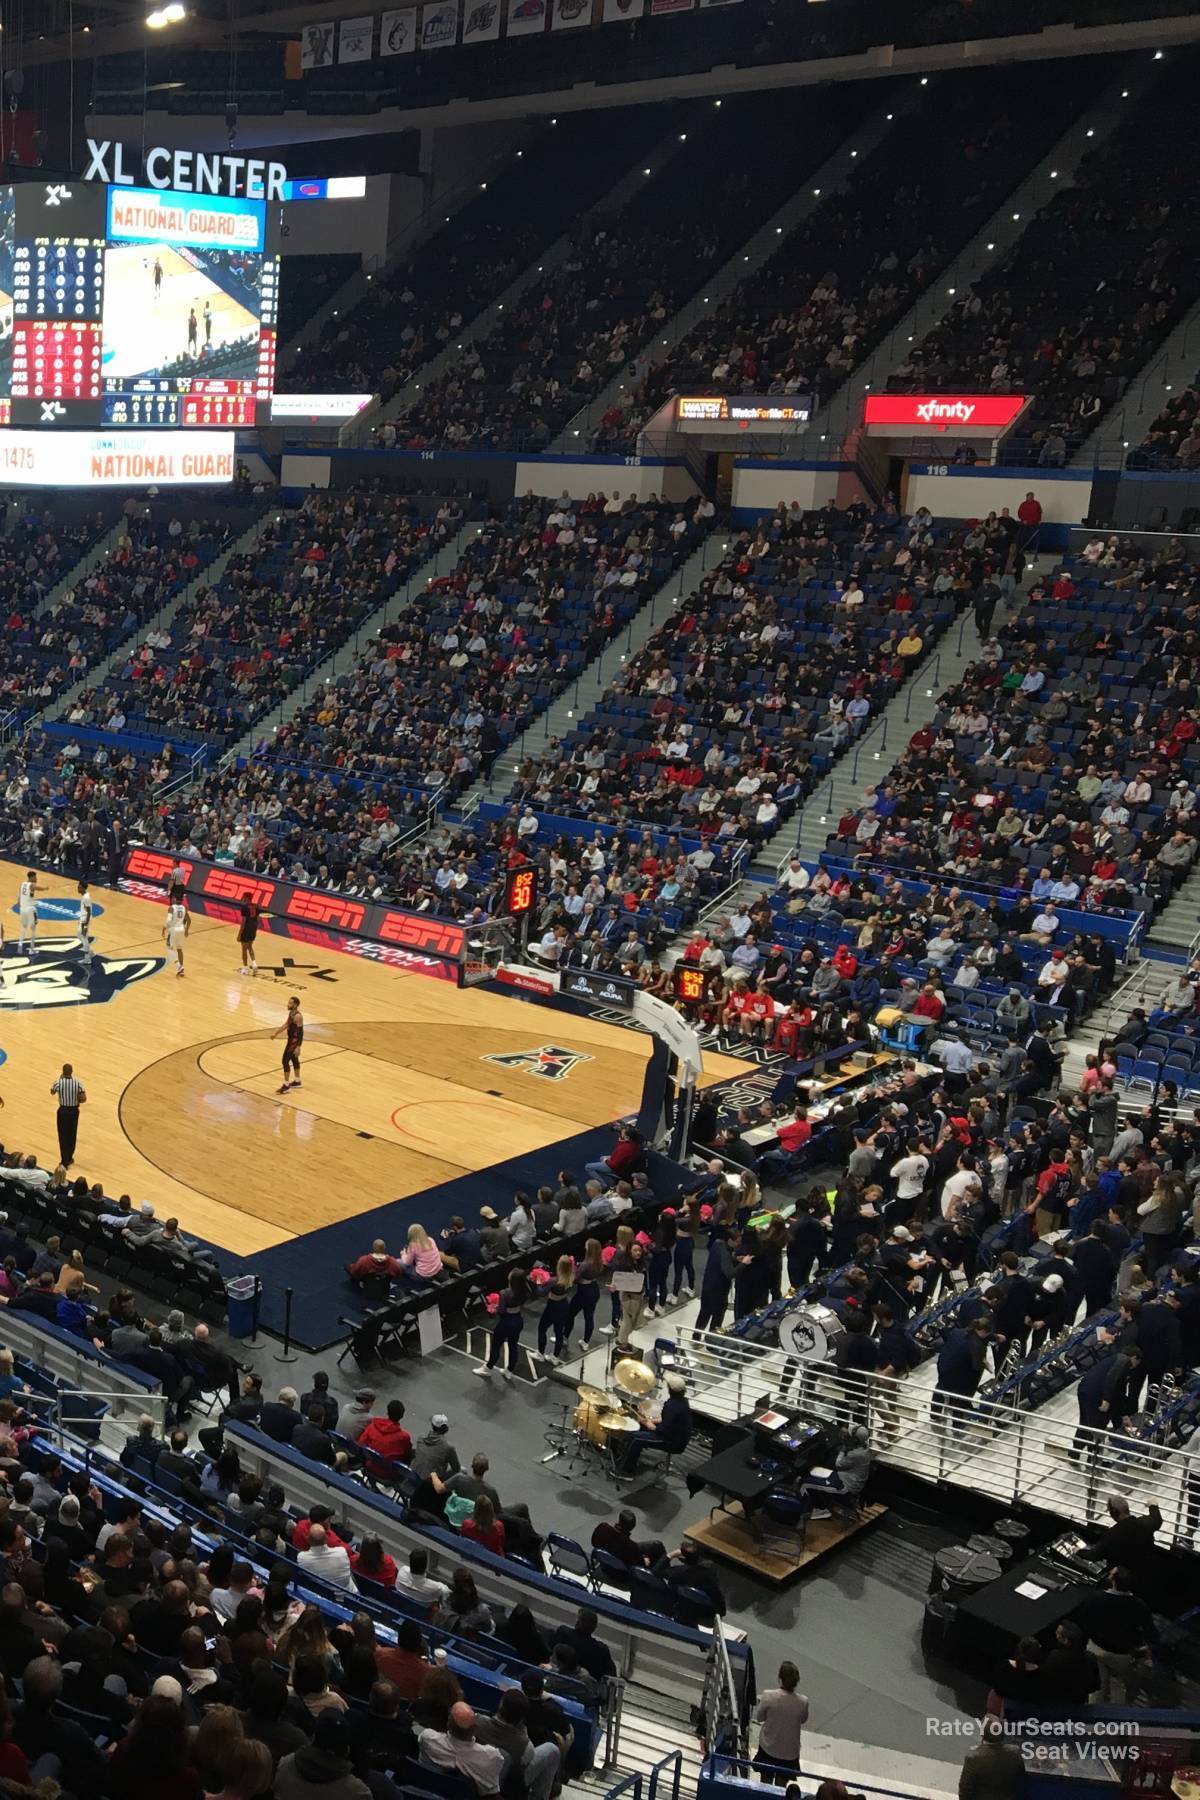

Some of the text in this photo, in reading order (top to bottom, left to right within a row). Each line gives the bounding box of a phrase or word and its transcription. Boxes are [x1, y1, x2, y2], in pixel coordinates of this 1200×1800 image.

[84, 138, 288, 201] XL CENTER
[114, 206, 235, 237] NATIONAL GUARD
[37, 247, 46, 257] 0
[57, 247, 66, 258] 0
[76, 248, 86, 258] 0
[96, 249, 102, 259] 1
[37, 261, 46, 272] 3
[58, 261, 64, 272] 1
[78, 262, 84, 272] 1
[94, 262, 102, 273] 0
[37, 275, 46, 286] 2
[55, 275, 66, 286] 0
[75, 276, 85, 286] 0
[94, 276, 102, 287] 0
[37, 289, 45, 300] 5
[56, 289, 65, 300] 0
[75, 289, 84, 300] 0
[95, 290, 100, 300] 1
[37, 303, 44, 313] 2
[57, 303, 63, 313] 1
[75, 303, 84, 314] 0
[95, 304, 100, 314] 1
[36, 331, 44, 341] 4
[54, 331, 64, 342] 0
[76, 332, 82, 342] 1
[94, 332, 99, 342] 1
[35, 345, 44, 356] 0
[56, 345, 62, 355] 1
[73, 345, 83, 356] 0
[91, 345, 100, 356] 0
[34, 359, 44, 370] 0
[53, 359, 63, 369] 0
[73, 359, 82, 370] 0
[91, 359, 99, 370] 0
[36, 372, 43, 383] 3
[54, 372, 62, 383] 2
[73, 372, 82, 383] 0
[91, 373, 99, 383] 0
[34, 385, 43, 397] 0
[54, 385, 62, 396] 2
[75, 386, 80, 397] 1
[91, 386, 99, 397] 0
[195, 382, 204, 392] 17
[684, 403, 720, 413] WATCH
[916, 401, 975, 421] xfinity
[732, 408, 808, 421] WatchForMeCT.org
[420, 451, 434, 460] 114
[624, 456, 640, 465] 115
[91, 453, 175, 479] NATIONAL
[927, 465, 948, 476] 116
[127, 851, 193, 887] ESPN
[516, 872, 533, 886] 8:52
[203, 870, 276, 908] ESPN
[510, 886, 530, 911] 30
[286, 890, 365, 930] ESPN
[379, 912, 465, 956] ESPN
[342, 945, 416, 967] HEALTH
[346, 939, 440, 966] UCONN
[254, 973, 308, 990] CENTER
[683, 971, 704, 982] 8:52
[571, 984, 594, 995] ACURA
[599, 990, 623, 1001] ACURA
[684, 983, 699, 997] 30
